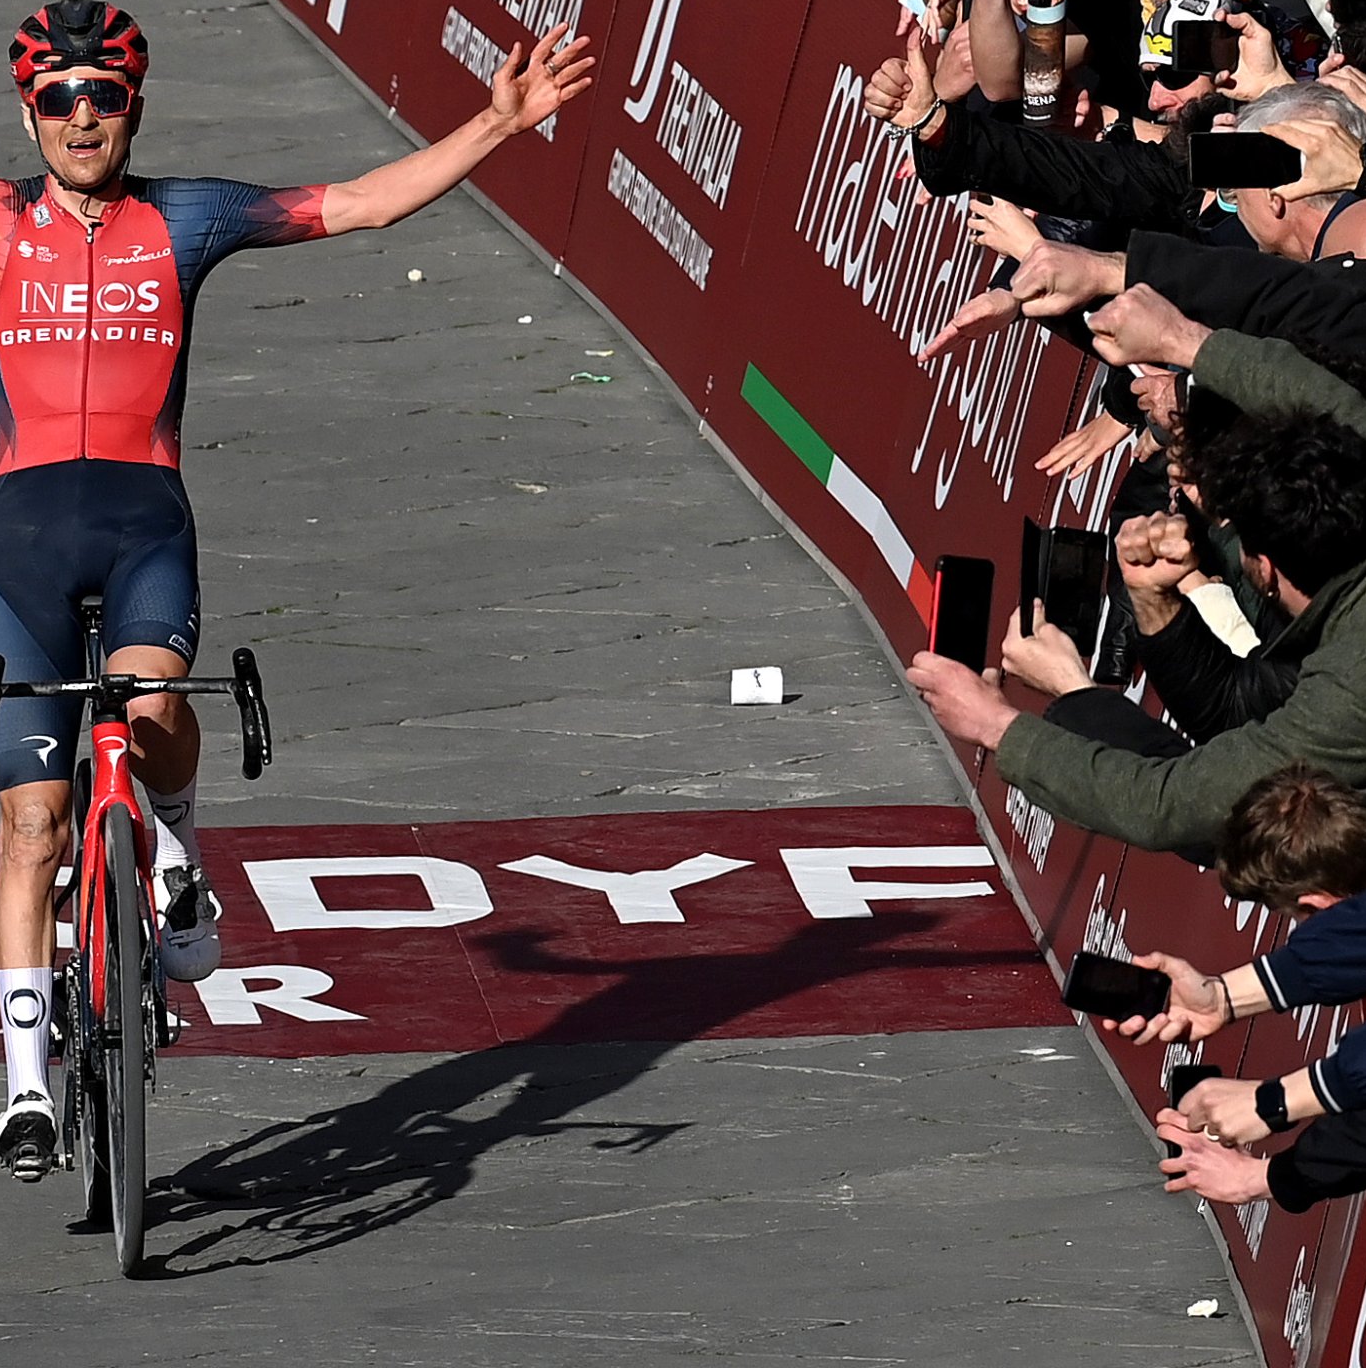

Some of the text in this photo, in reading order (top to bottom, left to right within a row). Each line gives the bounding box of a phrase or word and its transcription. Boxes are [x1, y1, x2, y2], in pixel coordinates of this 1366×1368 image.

[655, 60, 743, 212] TRENITALIA
[18, 279, 162, 314] INEOS
[0, 326, 176, 347] GRENADIER
